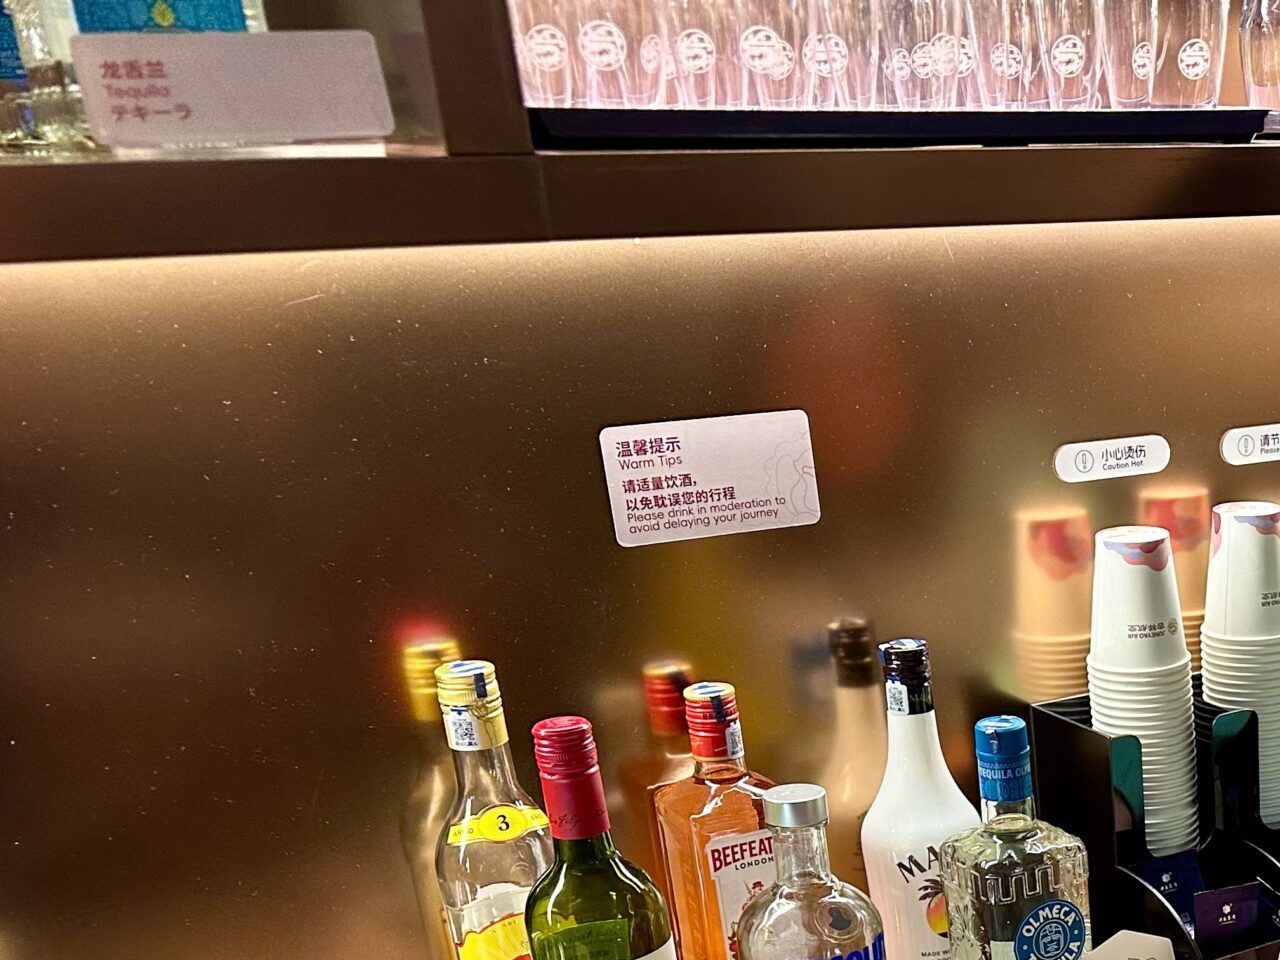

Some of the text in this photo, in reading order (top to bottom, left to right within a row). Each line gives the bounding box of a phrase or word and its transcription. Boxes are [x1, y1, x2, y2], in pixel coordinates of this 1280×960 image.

[616, 436, 681, 458] 温馨提示
[1102, 445, 1146, 462] 小心烫伤
[618, 454, 682, 470] Warm Tips
[1102, 462, 1129, 470] Caution
[626, 487, 736, 512] 以免耽误您的行程
[627, 496, 786, 523] Please drink in moderation to
[630, 508, 778, 534] avoid delaying your journey
[496, 814, 510, 831] 3
[711, 836, 773, 872] BEEFEAT
[735, 857, 774, 870] LONDON
[1022, 905, 1074, 937] OLMECA
